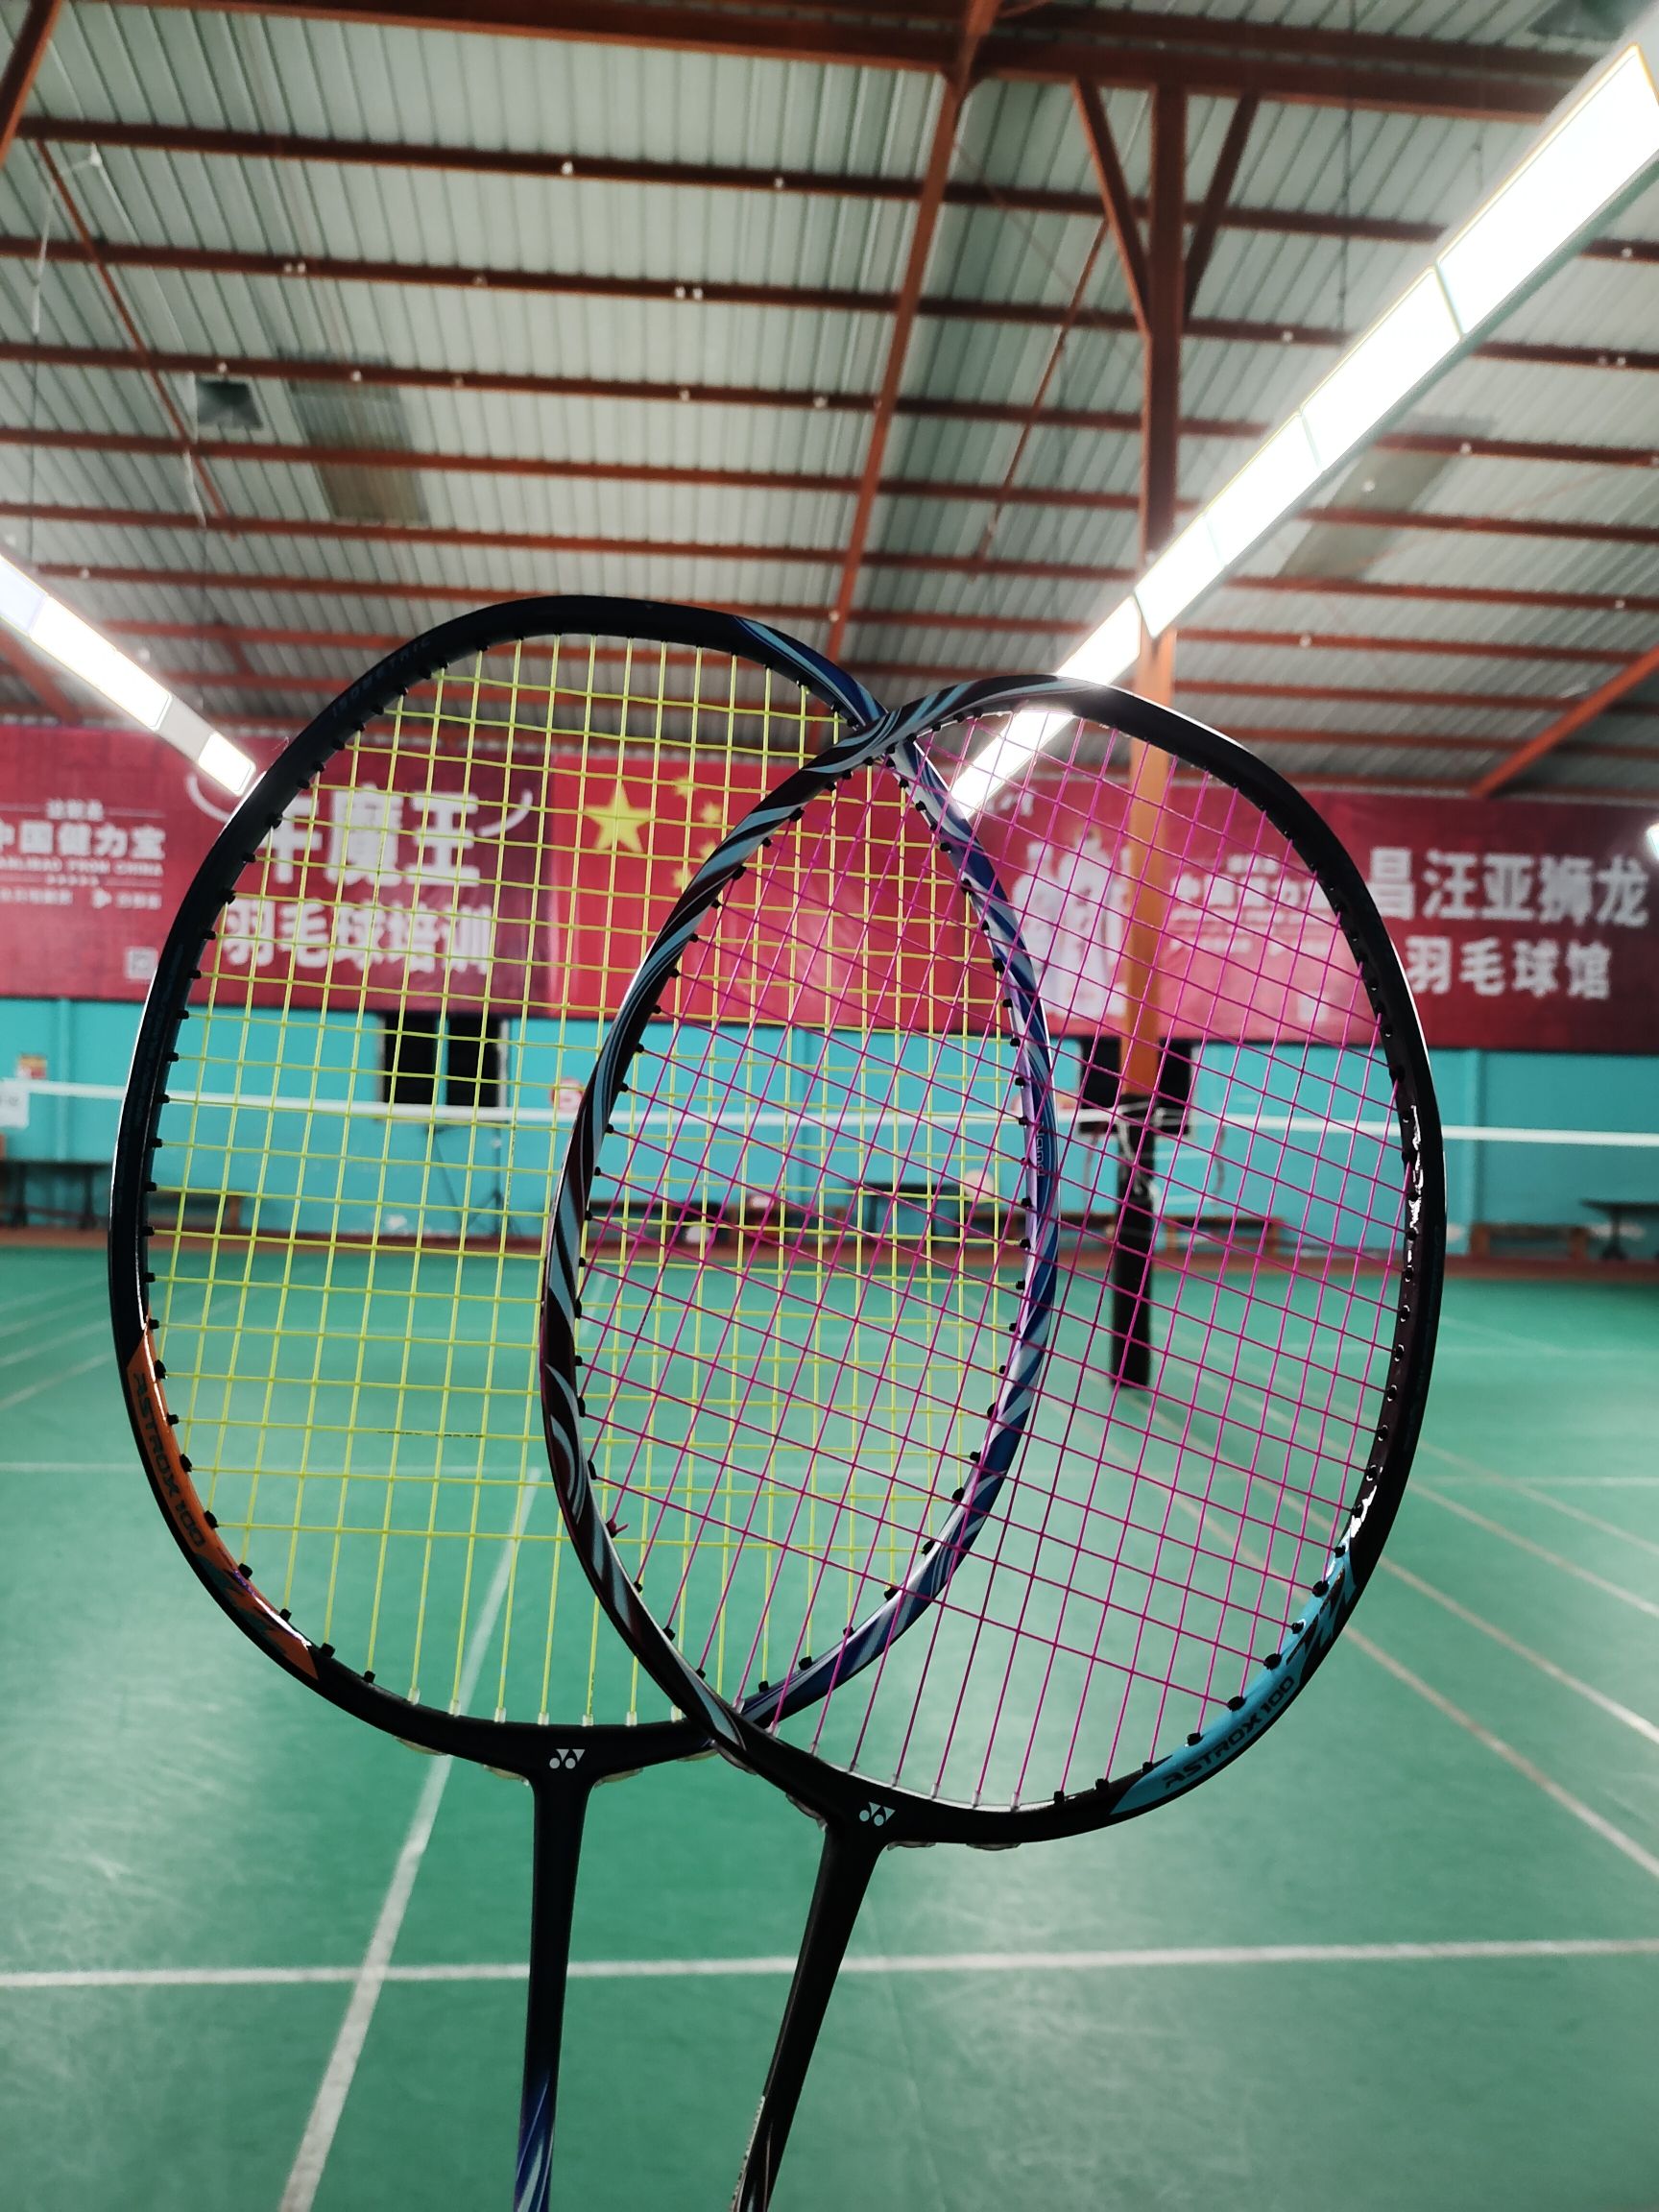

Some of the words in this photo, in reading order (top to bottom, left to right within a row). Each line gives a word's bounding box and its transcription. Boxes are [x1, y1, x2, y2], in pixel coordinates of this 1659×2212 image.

[222, 897, 493, 975] 羽毛球培训
[1405, 934, 1612, 1000] 羽毛球馆
[132, 1371, 180, 1499] ASTROX
[176, 1500, 206, 1549] 100
[1161, 1712, 1262, 1790] ASTROX
[1260, 1675, 1295, 1715] 100
